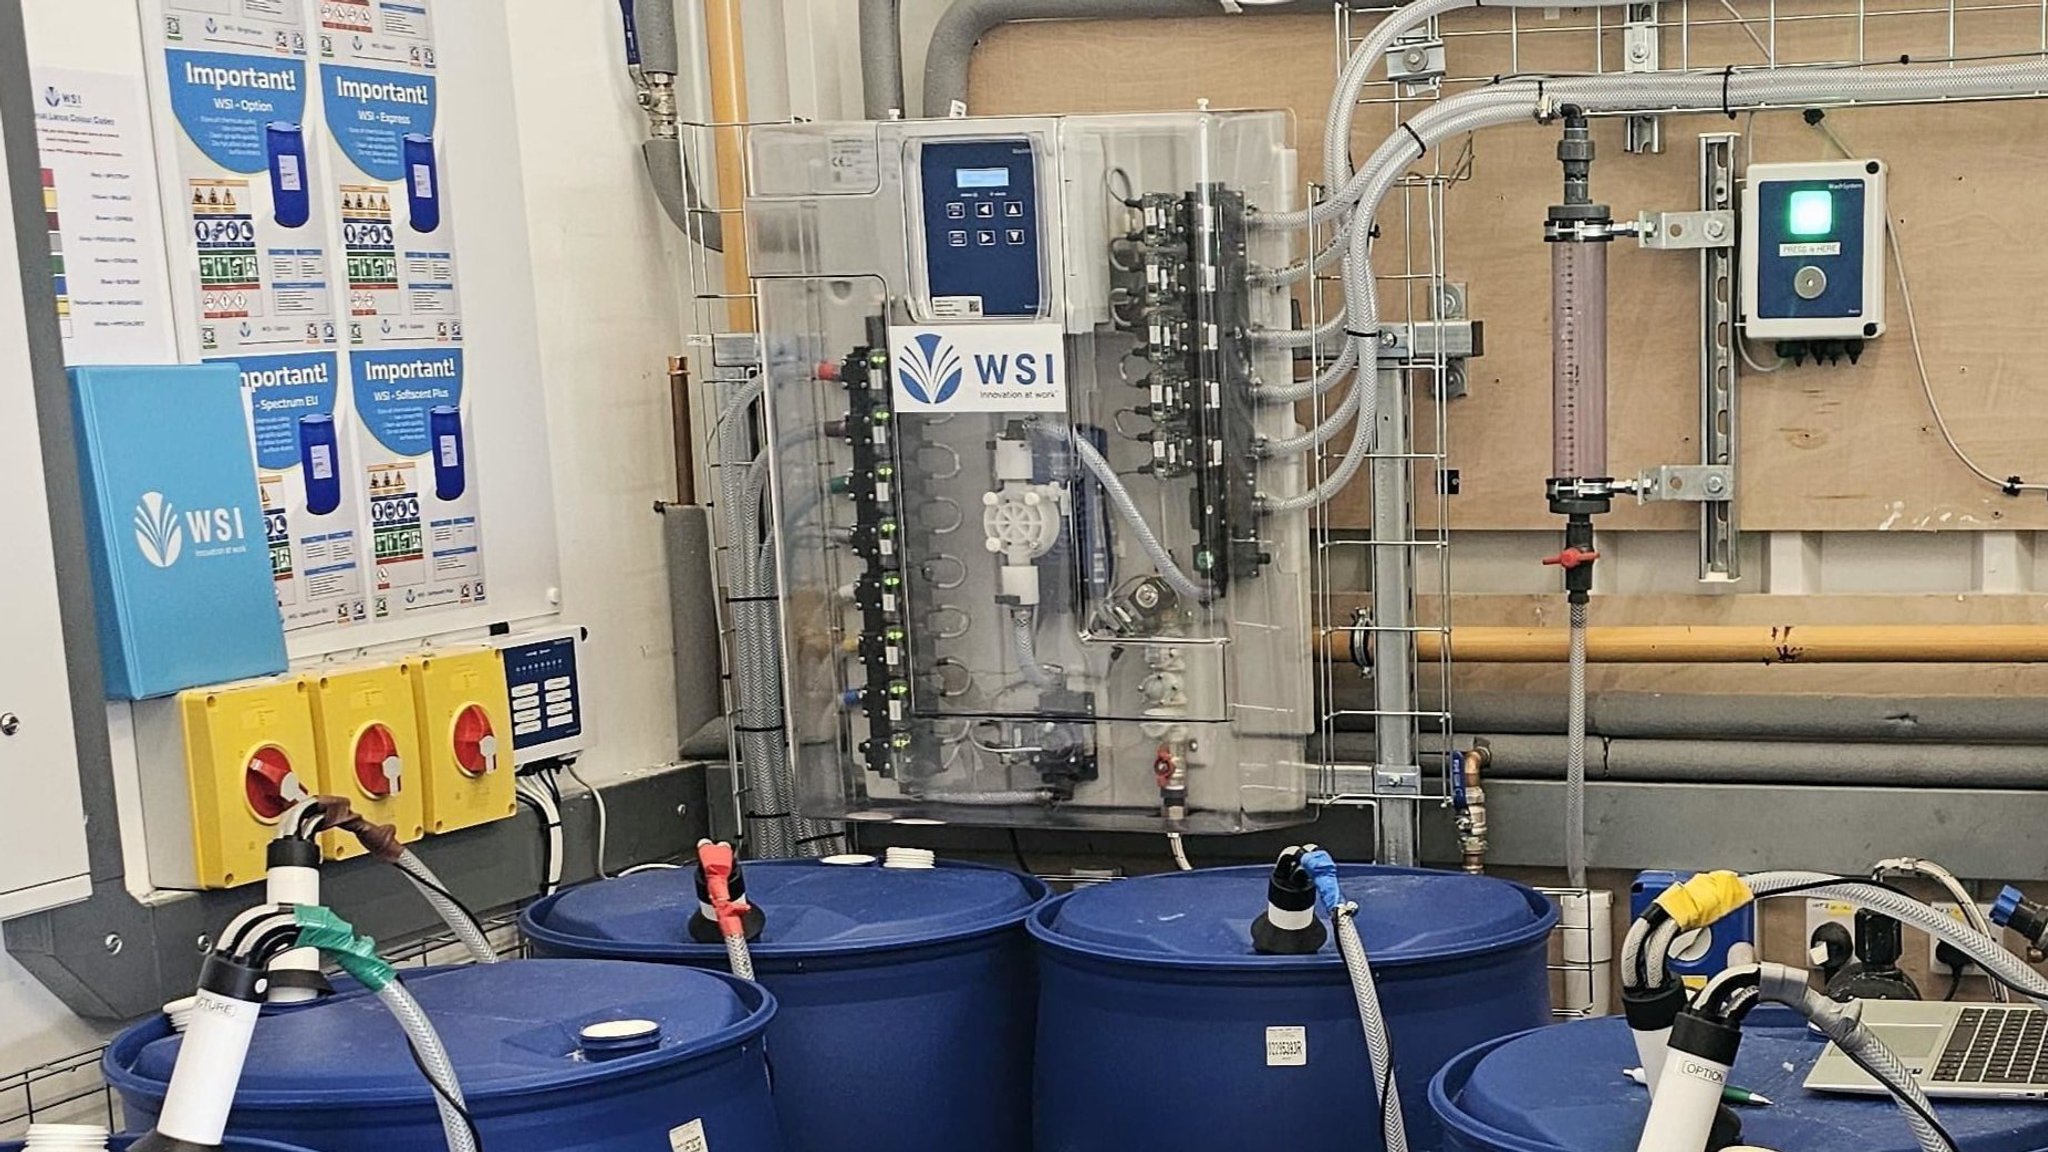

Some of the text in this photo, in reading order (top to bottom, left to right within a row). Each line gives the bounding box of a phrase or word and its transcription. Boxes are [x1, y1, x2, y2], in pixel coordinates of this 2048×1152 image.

[185, 61, 297, 91] Important!
[336, 75, 428, 106] Important!
[212, 98, 234, 110] WSI
[240, 99, 274, 113] Option
[357, 110, 375, 121] WSI
[365, 357, 456, 384] Important!
[974, 353, 1054, 386] WSI
[260, 397, 305, 412] Spectrum
[373, 390, 391, 402] WSI
[185, 506, 245, 544] WSI
